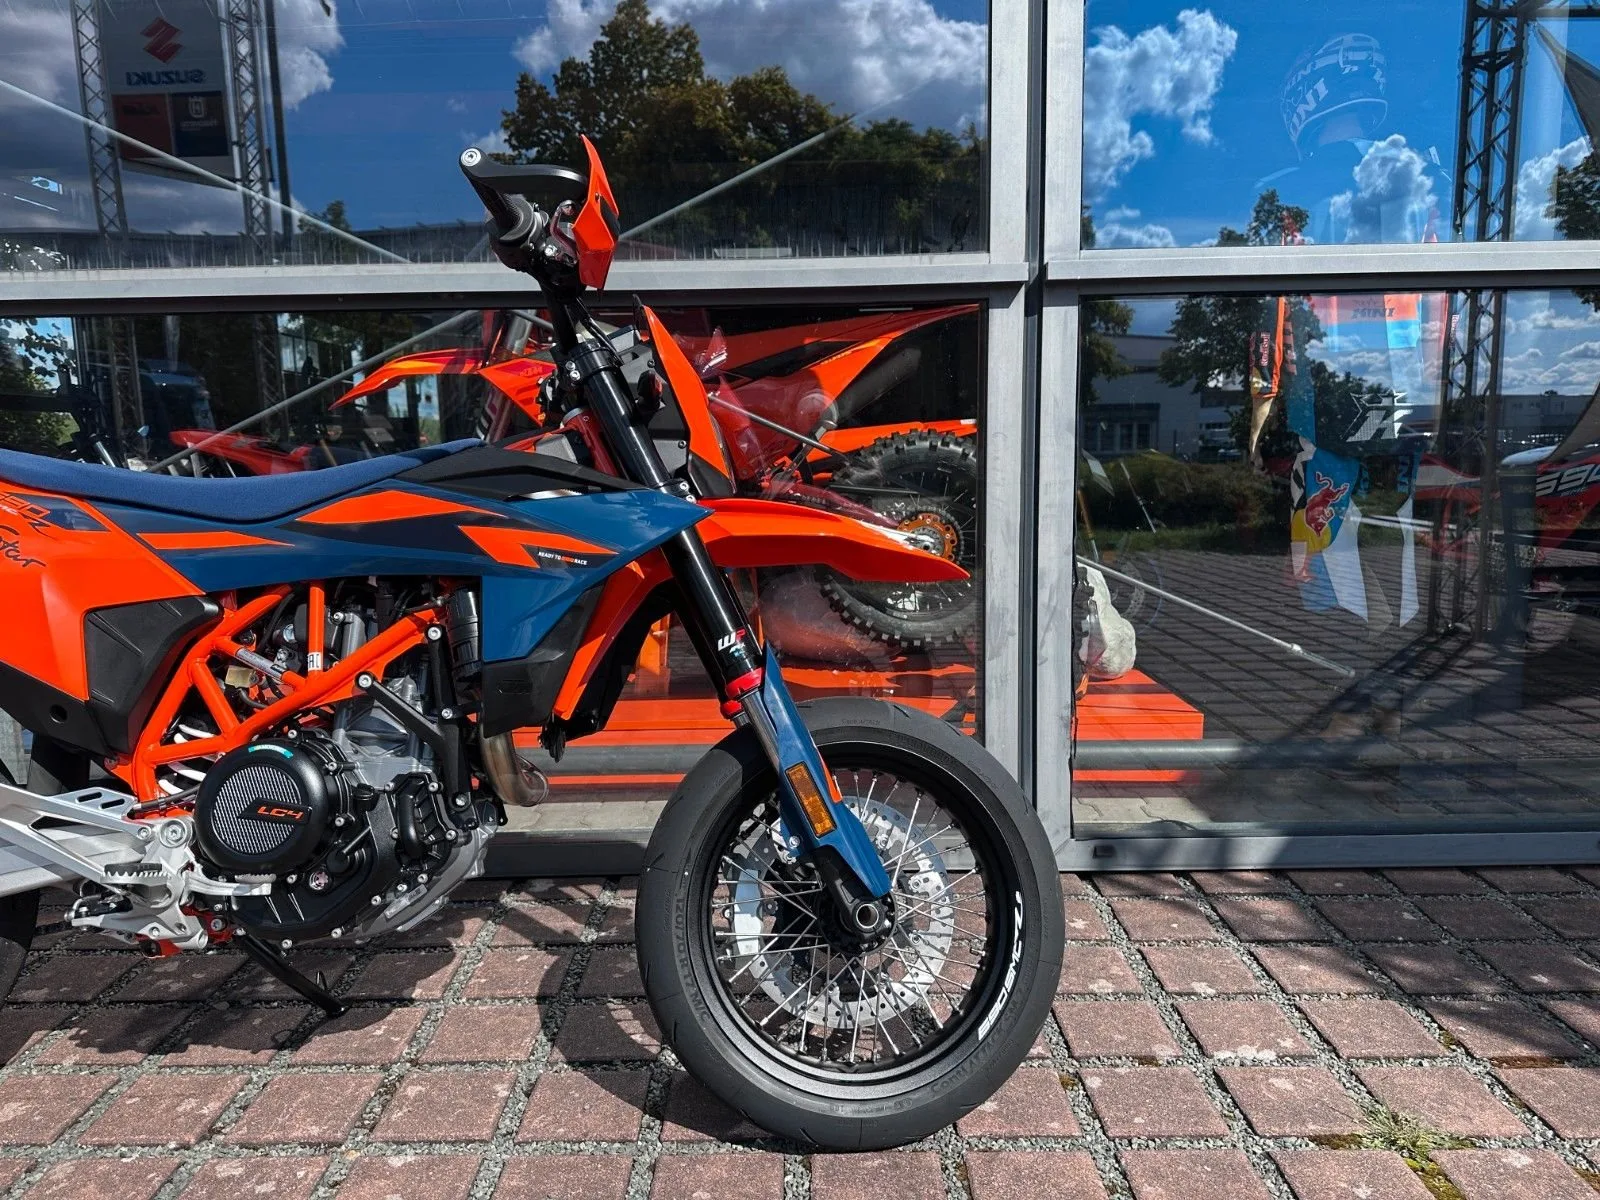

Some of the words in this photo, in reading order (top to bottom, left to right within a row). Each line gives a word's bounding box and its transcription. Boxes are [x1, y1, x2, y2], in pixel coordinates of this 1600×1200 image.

[538, 551, 554, 559] READY
[573, 558, 588, 566] RACE
[717, 628, 746, 652] WP
[257, 806, 304, 819] LC4
